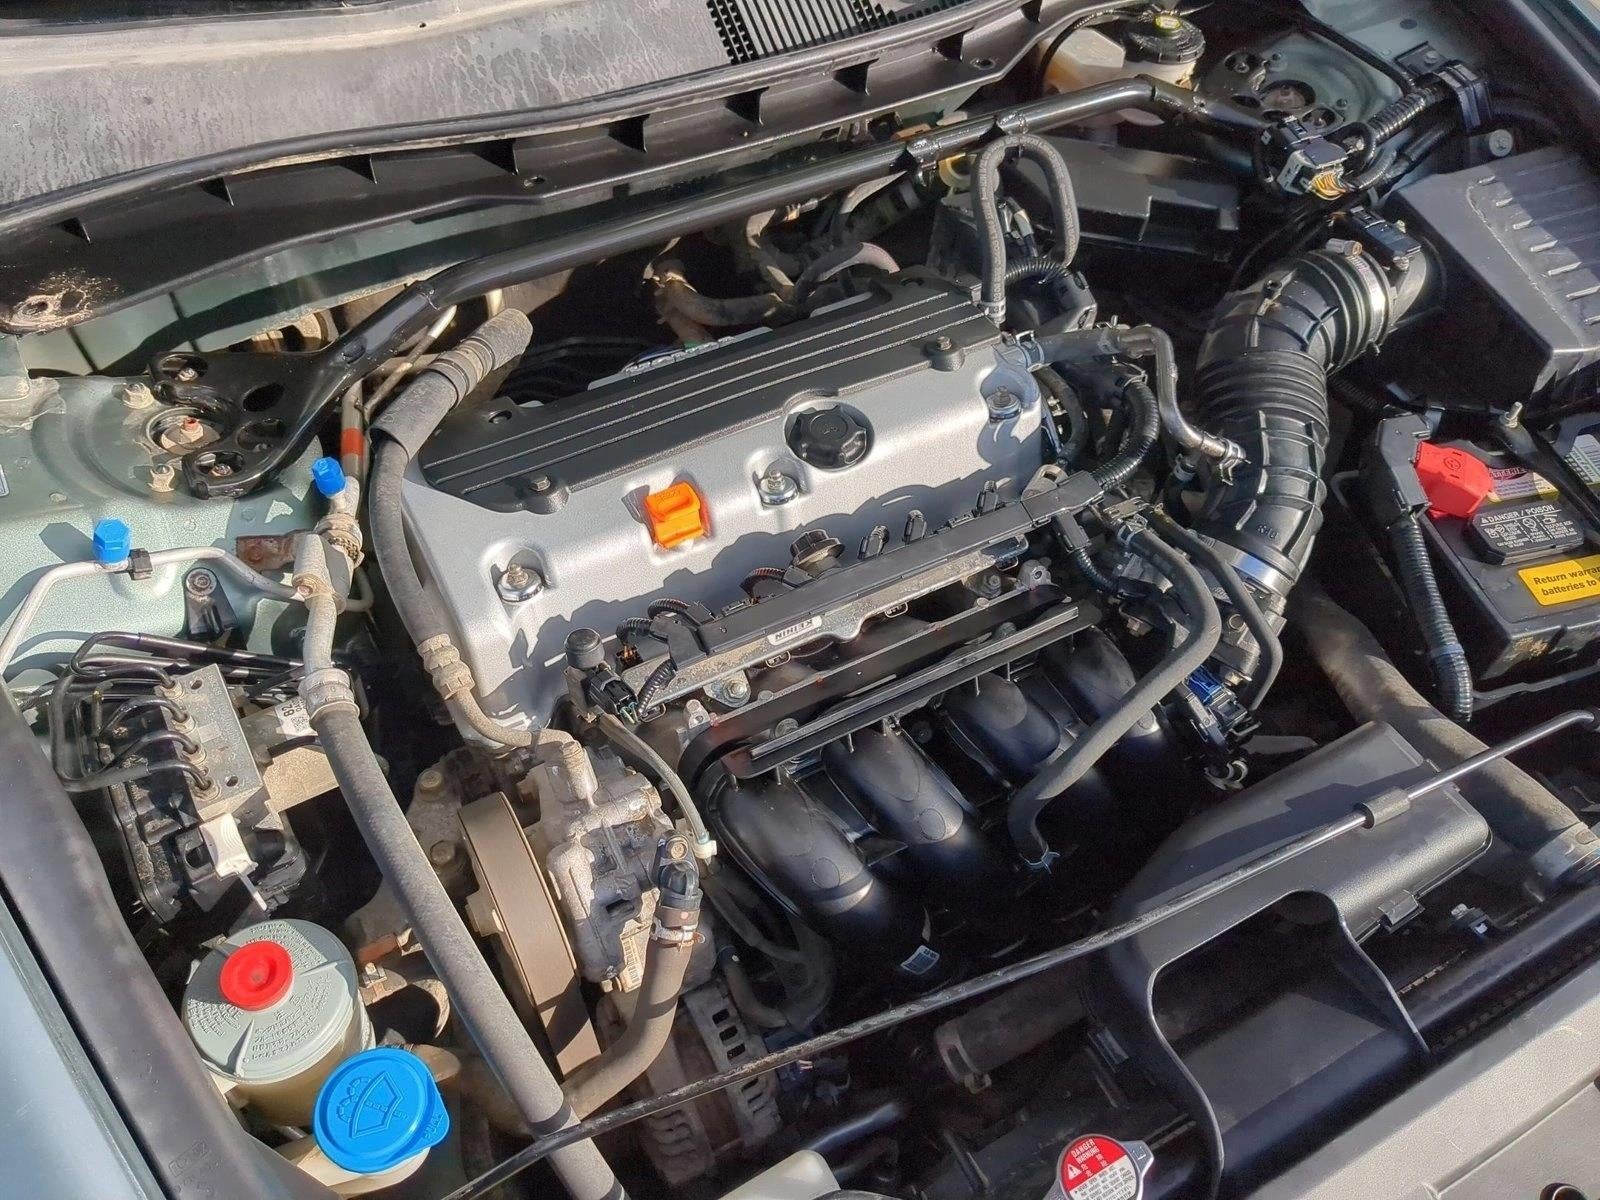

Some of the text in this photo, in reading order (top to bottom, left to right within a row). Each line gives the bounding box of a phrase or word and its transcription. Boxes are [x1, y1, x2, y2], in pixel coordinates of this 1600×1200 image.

[1488, 511, 1520, 523] DANGER
[1525, 504, 1555, 515] POISON
[1533, 573, 1567, 585] Return
[1541, 579, 1598, 596] batteries to
[775, 619, 813, 640] KEIHIN
[1071, 1138, 1096, 1159] DANGER
